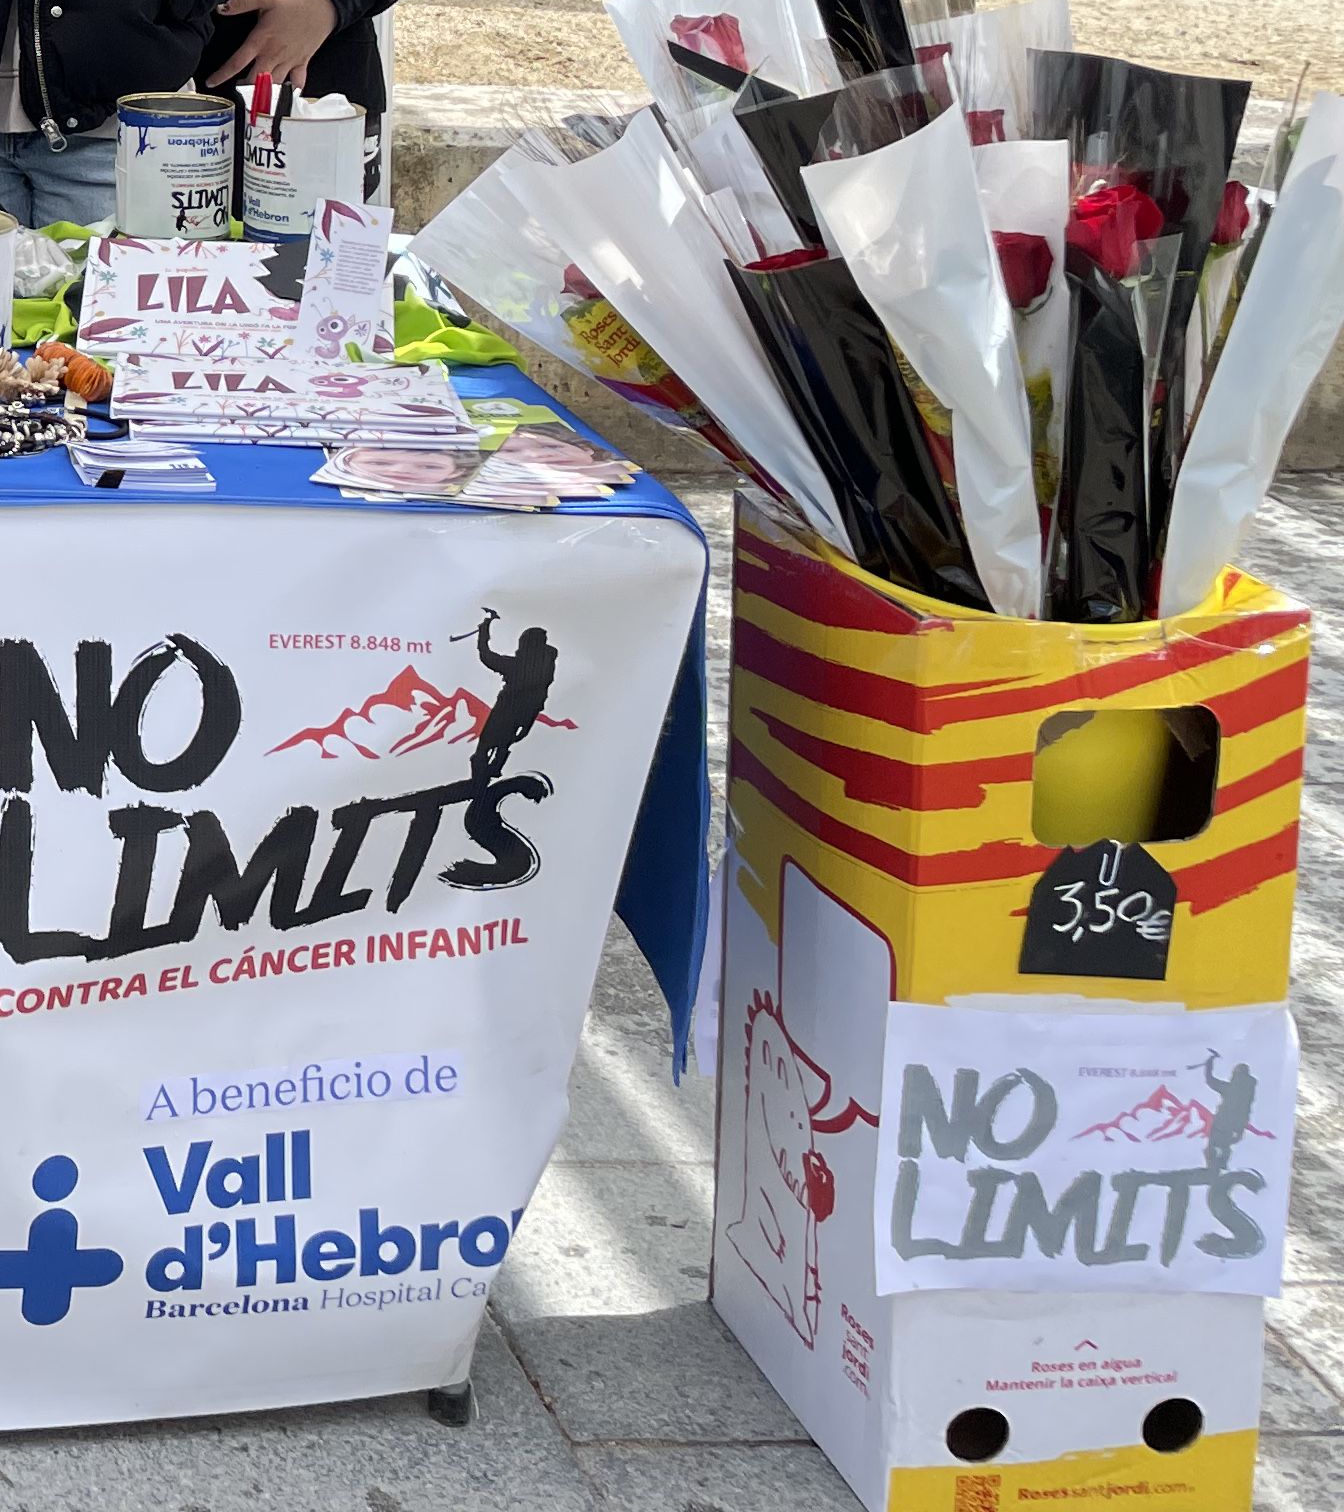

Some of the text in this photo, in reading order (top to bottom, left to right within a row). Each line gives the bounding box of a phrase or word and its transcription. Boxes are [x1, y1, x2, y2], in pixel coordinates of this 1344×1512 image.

[137, 273, 251, 315] LILA
[579, 310, 617, 345] Roses
[594, 323, 629, 354] Sant
[269, 632, 433, 656] EVEREST 8.848 mt
[1053, 880, 1172, 942] 3,50€
[158, 966, 199, 993] EL
[207, 945, 356, 986] CÁNCER
[366, 918, 529, 964] INFANTIL
[144, 1054, 458, 1122] A beneficio de
[897, 1063, 1058, 1164] NO
[143, 1129, 312, 1216] Vall
[891, 1157, 1270, 1268] LIMITS
[143, 1281, 442, 1320] Barcelona Hospital
[840, 1302, 874, 1350] Roses
[841, 1339, 870, 1380] jordi
[1031, 1355, 1144, 1374] Roses en aigua
[985, 1369, 1179, 1394] Mantenir la caixa vertical
